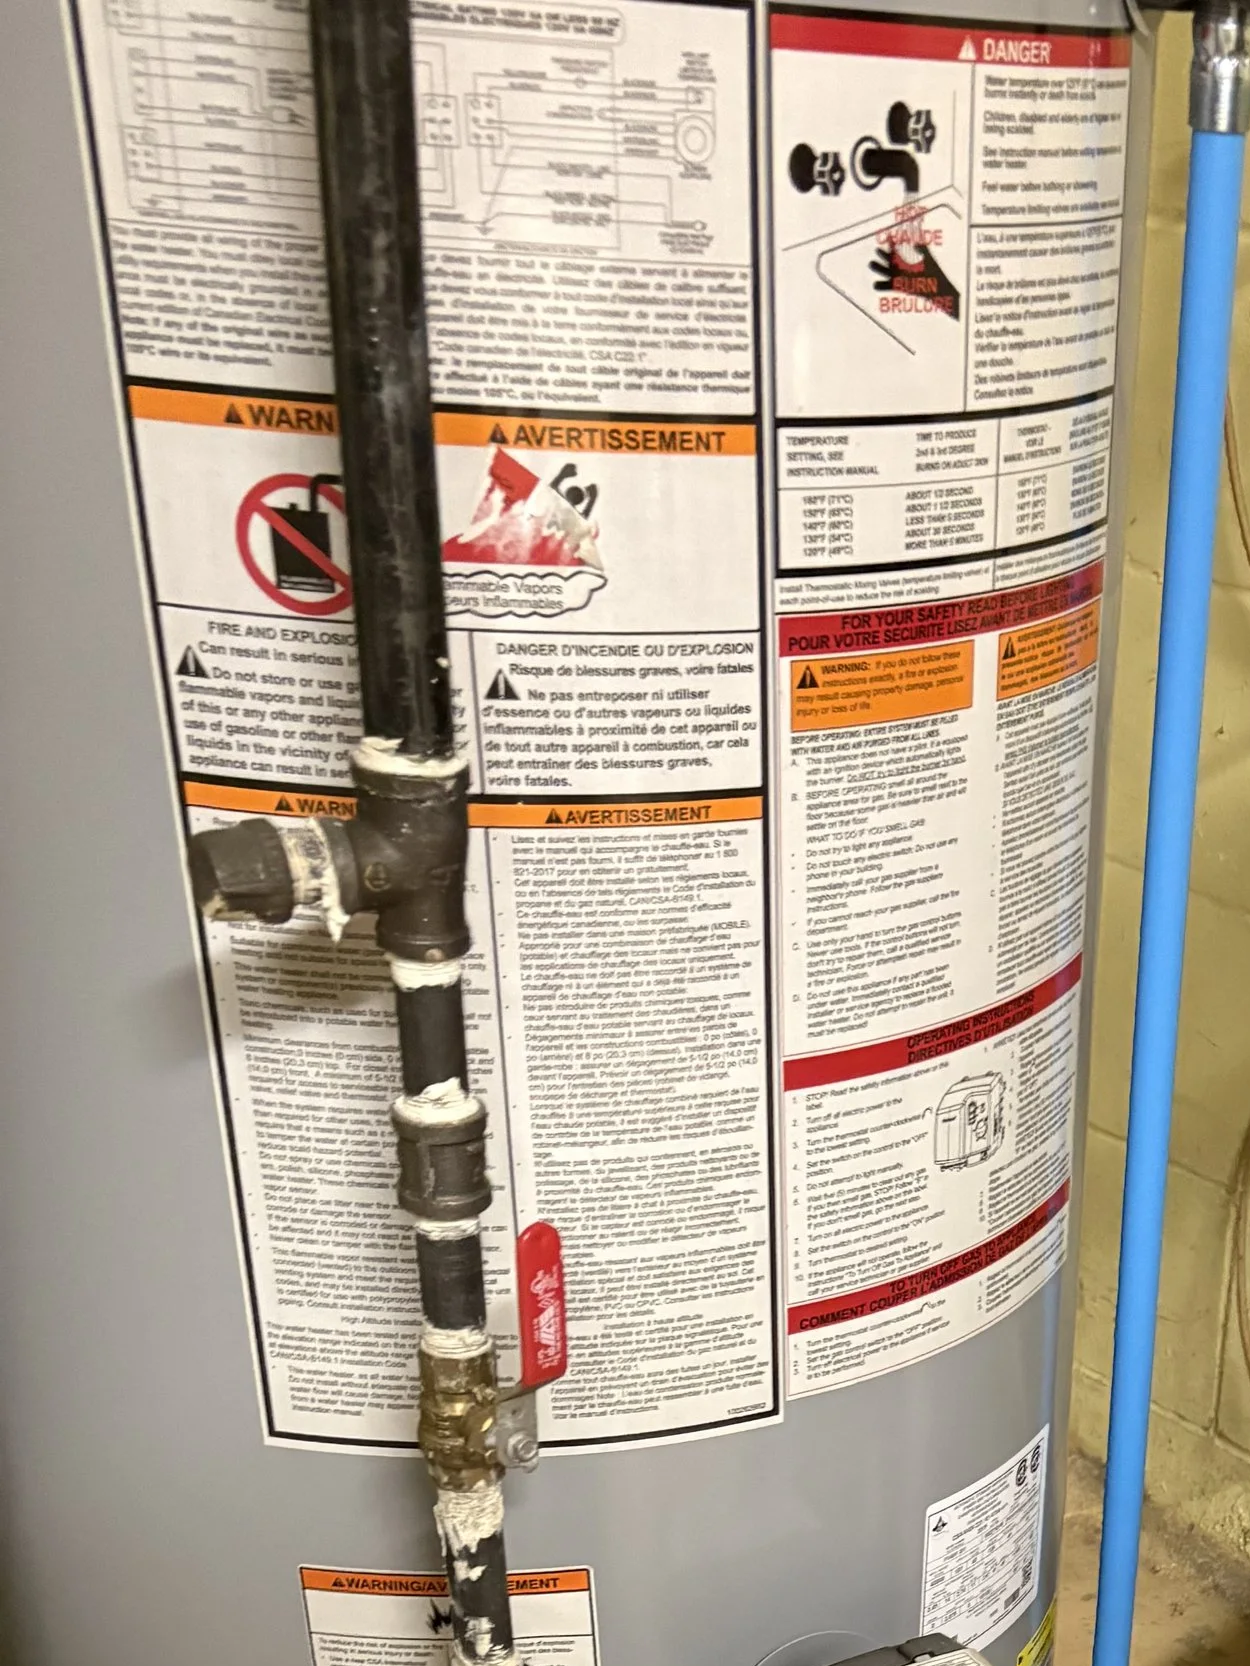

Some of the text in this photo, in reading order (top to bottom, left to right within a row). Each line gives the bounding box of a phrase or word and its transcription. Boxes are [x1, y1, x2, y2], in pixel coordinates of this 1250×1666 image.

[983, 37, 1051, 64] DANGER
[892, 277, 938, 293] BURN
[247, 406, 335, 432] WARN
[514, 425, 726, 451] AVERTISSEMENT
[786, 435, 848, 445] TEMPERATURE
[445, 578, 563, 595] ammable Vapors
[841, 613, 871, 629] FOR
[874, 609, 913, 625] YOUR
[917, 602, 964, 621] SAFETY
[967, 597, 998, 613] READ
[244, 626, 277, 639] AND
[280, 630, 357, 646] EXPLOSIO
[788, 635, 830, 650] POUR
[833, 630, 880, 647] VOTRE
[883, 623, 944, 642] SECURITE
[947, 617, 977, 634] LISEZ
[198, 640, 226, 654] Can
[272, 648, 287, 660] in
[643, 644, 664, 656] OU
[556, 665, 573, 676] de
[820, 661, 870, 673] WARNING:
[210, 666, 231, 679] Do
[234, 671, 257, 682] not
[298, 677, 313, 687] or
[316, 679, 344, 690] use
[298, 695, 324, 706] and
[527, 689, 546, 700] Ne
[549, 691, 573, 703] pas
[651, 689, 663, 700] ni
[180, 699, 195, 710] of
[224, 706, 239, 716] or
[241, 708, 266, 721] any
[307, 713, 361, 727] applian
[552, 709, 571, 718] ou
[684, 707, 701, 716] ou
[183, 719, 207, 730] use
[209, 720, 222, 731] of
[281, 729, 296, 739] or
[650, 723, 666, 734] de
[669, 723, 688, 734] cet
[741, 721, 757, 730] ou
[235, 740, 250, 752] in
[252, 742, 276, 755] the
[335, 751, 349, 763] of
[483, 740, 501, 751] de
[706, 739, 724, 749] car
[250, 762, 273, 771] can
[314, 765, 325, 775] in
[574, 758, 598, 769] des
[297, 799, 354, 816] WARN
[564, 806, 712, 823] AVERTISSEMENT
